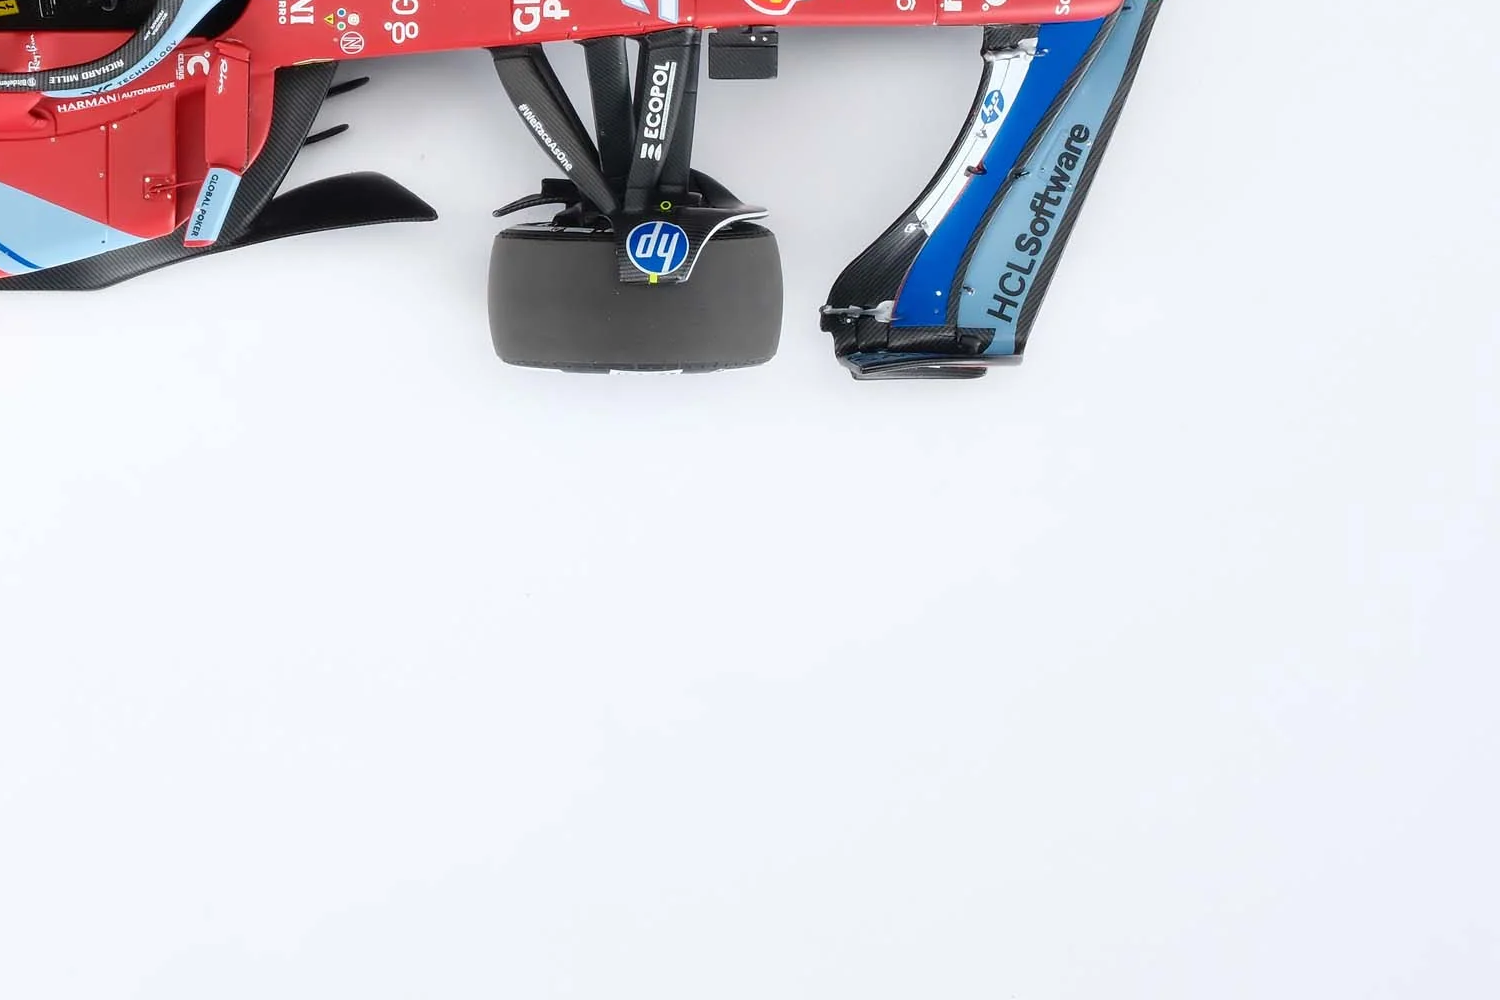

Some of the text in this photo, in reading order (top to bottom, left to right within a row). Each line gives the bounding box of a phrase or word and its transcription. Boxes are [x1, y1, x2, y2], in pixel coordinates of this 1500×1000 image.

[49, 59, 125, 84] RICHARD MILLE
[117, 40, 177, 86] TECHNOLOGY
[57, 82, 176, 113] HARMAN AUTOMOTIVE
[644, 61, 670, 139] ECOPOL
[518, 103, 573, 172] #WeRaceAsOne
[191, 174, 219, 237] GLOBAL POKER
[987, 123, 1090, 323] HCLSoftware
[635, 222, 680, 273] hp
